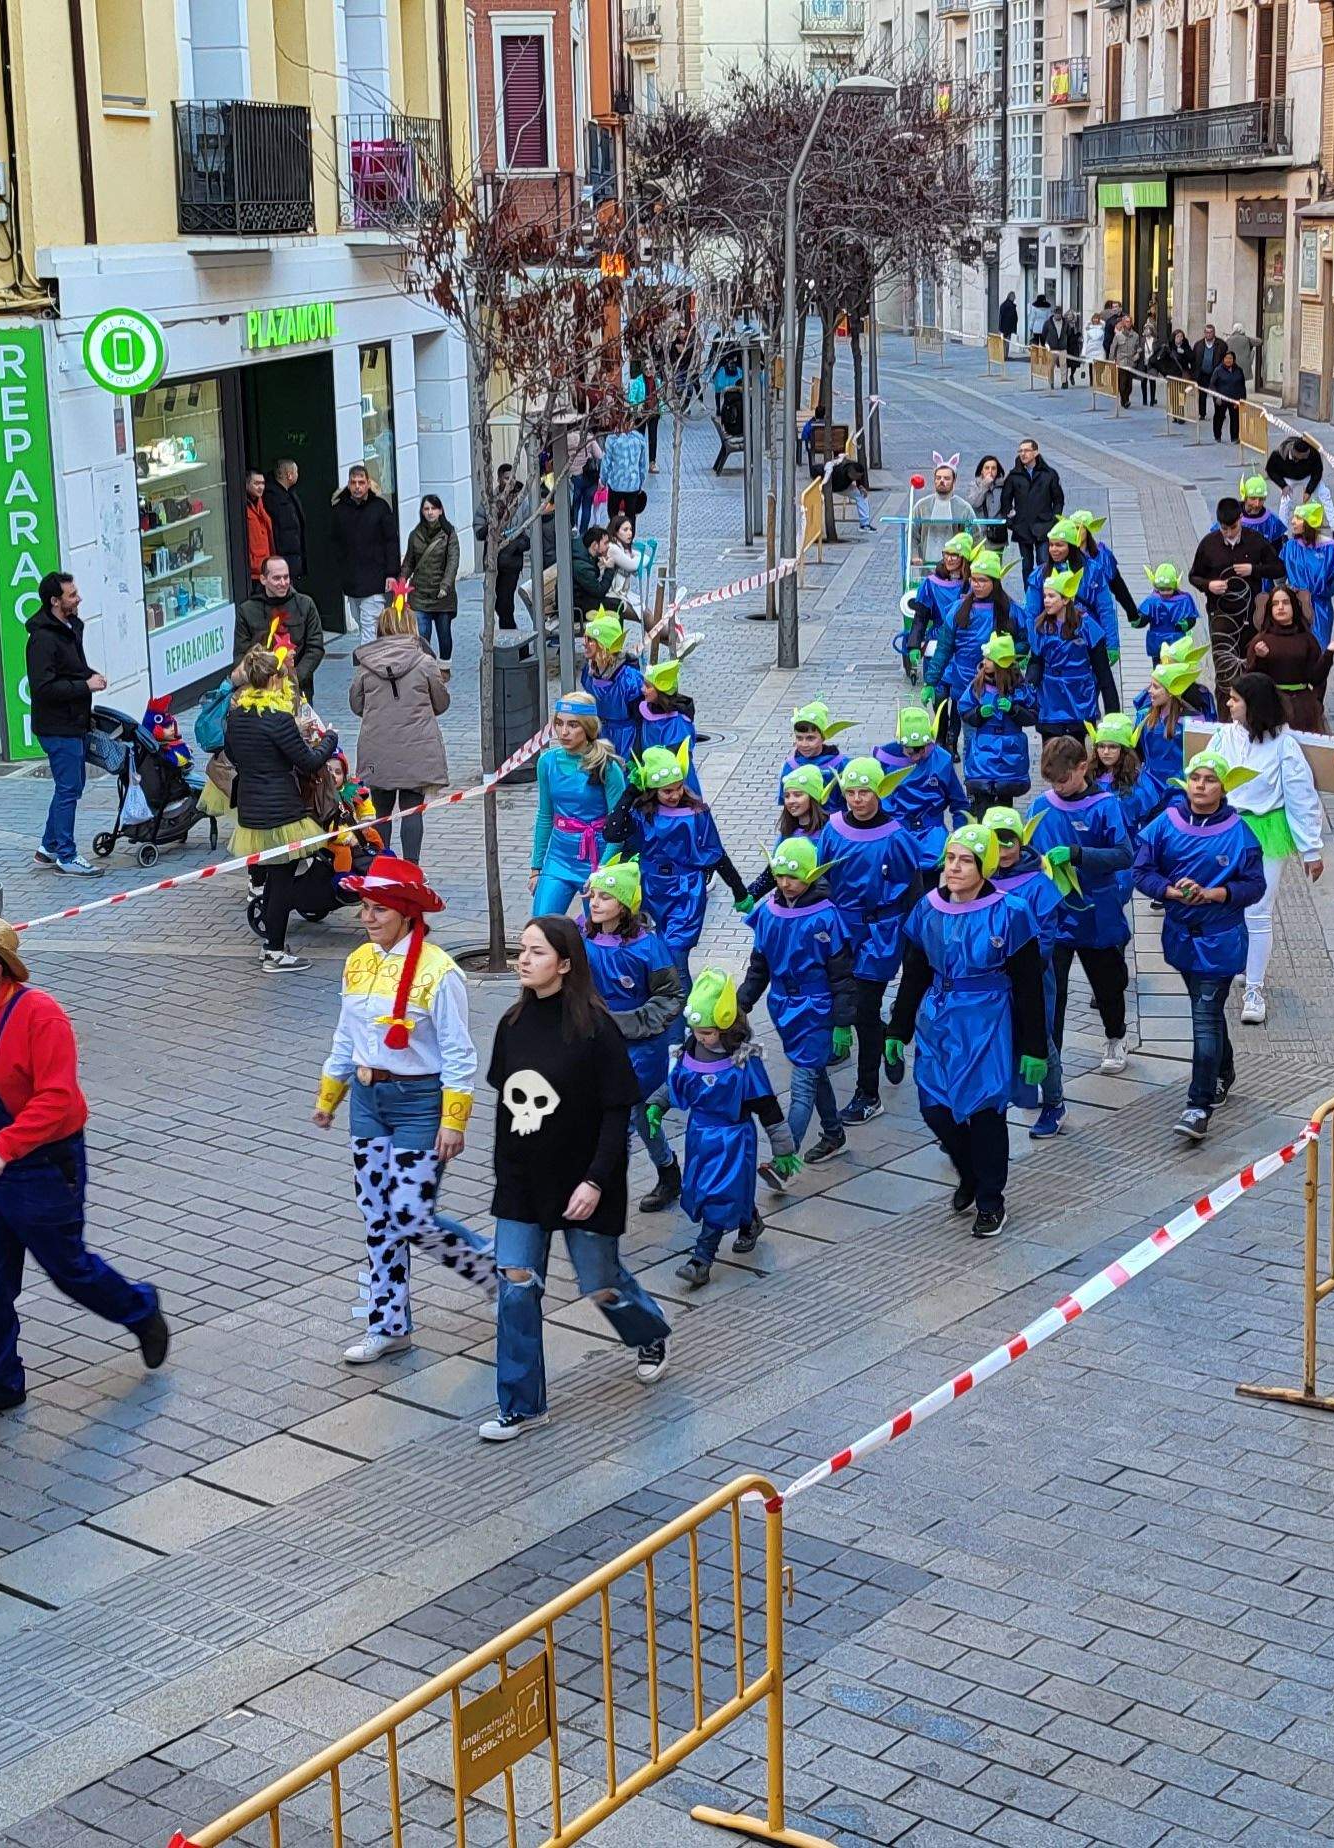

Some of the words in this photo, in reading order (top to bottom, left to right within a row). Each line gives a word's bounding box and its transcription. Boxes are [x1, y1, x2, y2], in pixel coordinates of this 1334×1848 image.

[101, 318, 144, 334] PLAZA
[246, 301, 340, 350] PLAZAMOVIL
[165, 626, 225, 675] REPARACIONES
